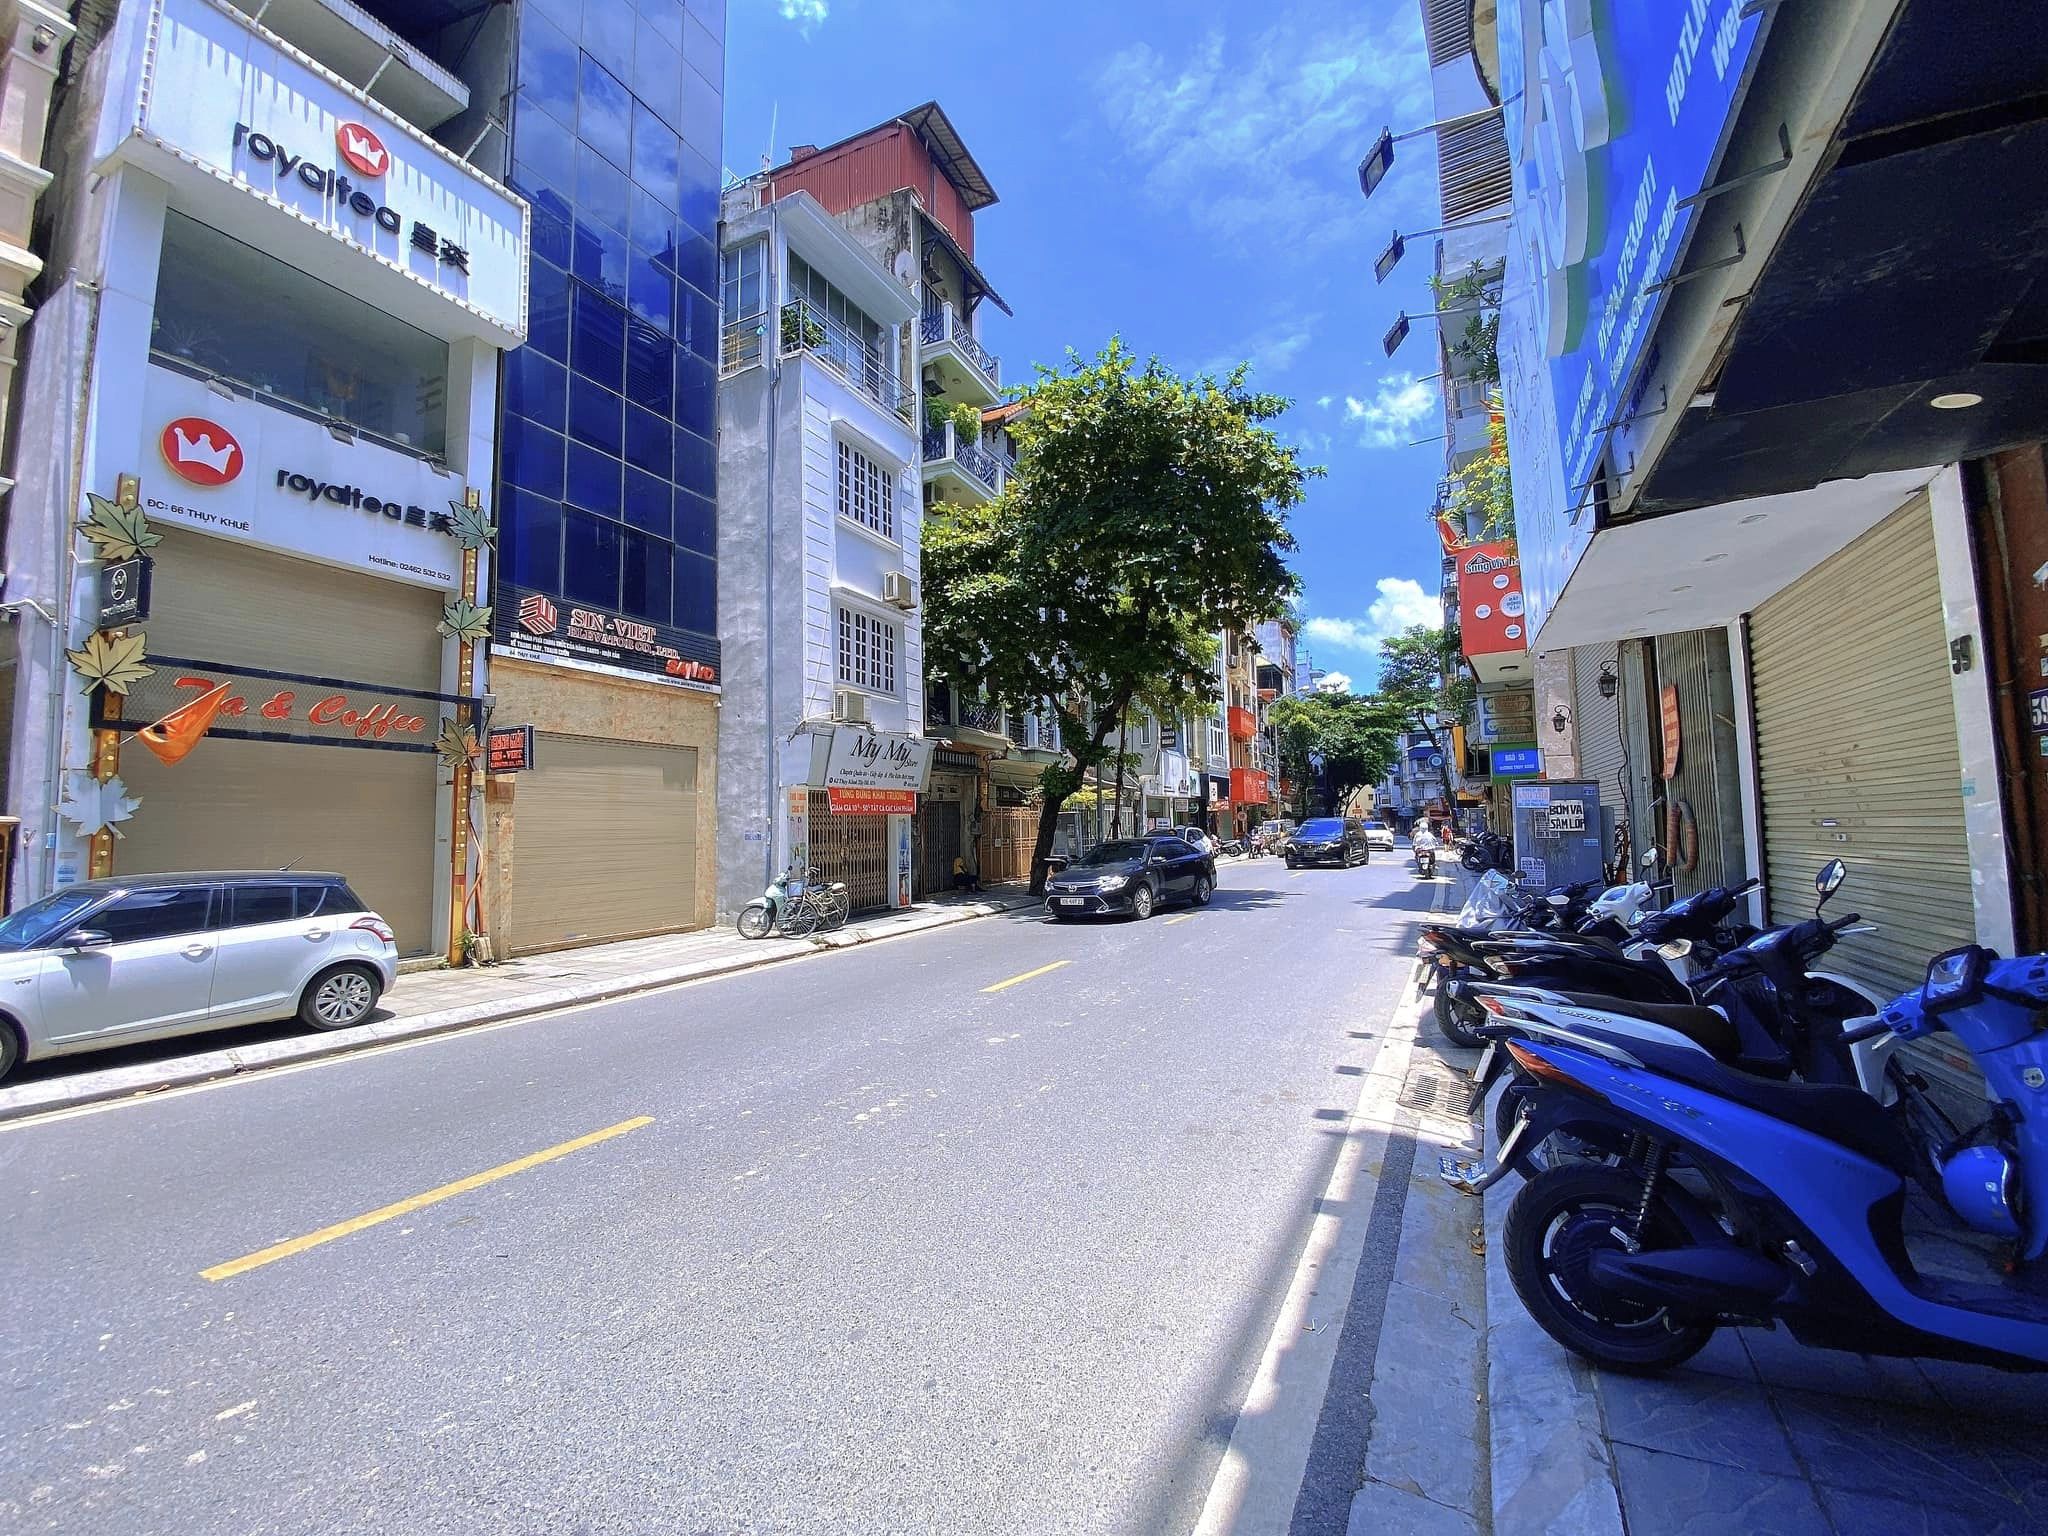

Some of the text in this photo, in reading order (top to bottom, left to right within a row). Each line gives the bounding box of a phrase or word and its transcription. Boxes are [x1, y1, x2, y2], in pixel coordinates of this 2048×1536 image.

[233, 122, 401, 235] royaltea
[147, 498, 250, 532] ĐC: 66 THỤY KHUÊ
[277, 469, 402, 521] royaltea
[368, 554, 399, 569] Hotline:
[424, 567, 437, 578] 532
[437, 571, 451, 582] 532
[567, 625, 634, 650] ELEVATOR
[261, 691, 295, 719] &
[308, 695, 426, 738] Coffee
